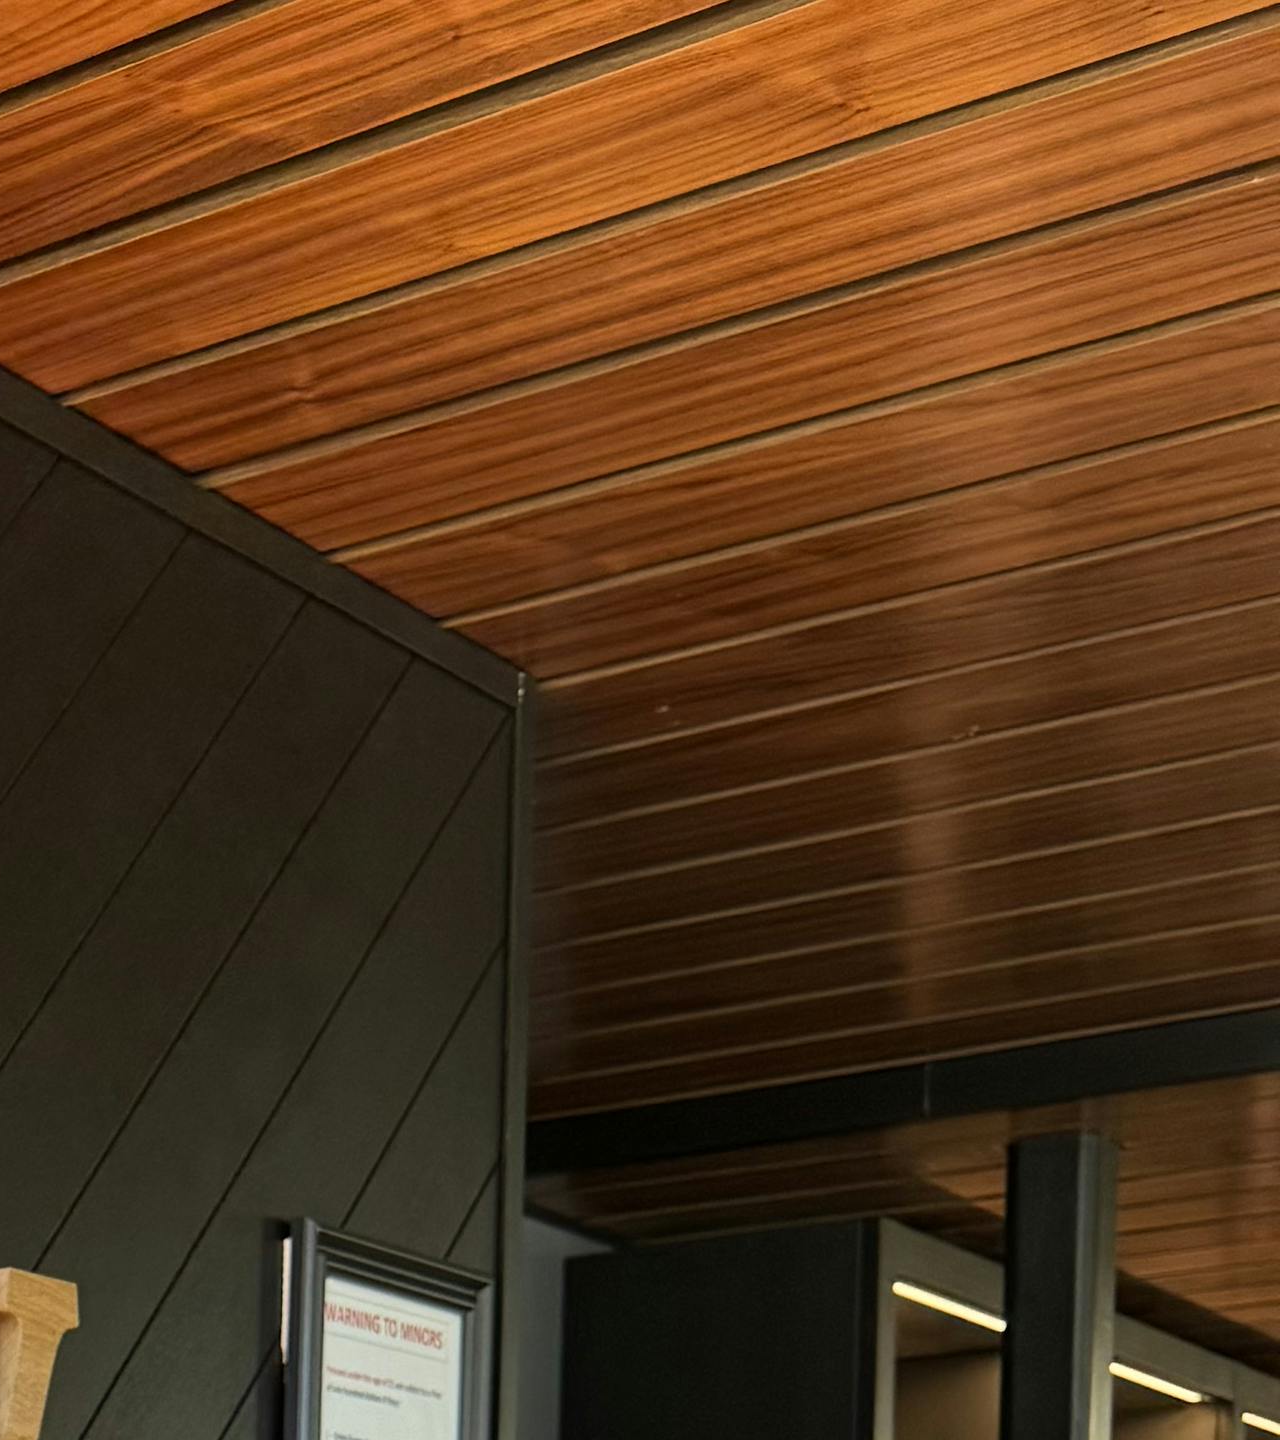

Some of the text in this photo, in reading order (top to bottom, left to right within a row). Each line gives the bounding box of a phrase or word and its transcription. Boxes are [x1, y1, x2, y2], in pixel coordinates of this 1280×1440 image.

[324, 1303, 443, 1350] WARNING TO MINORS
